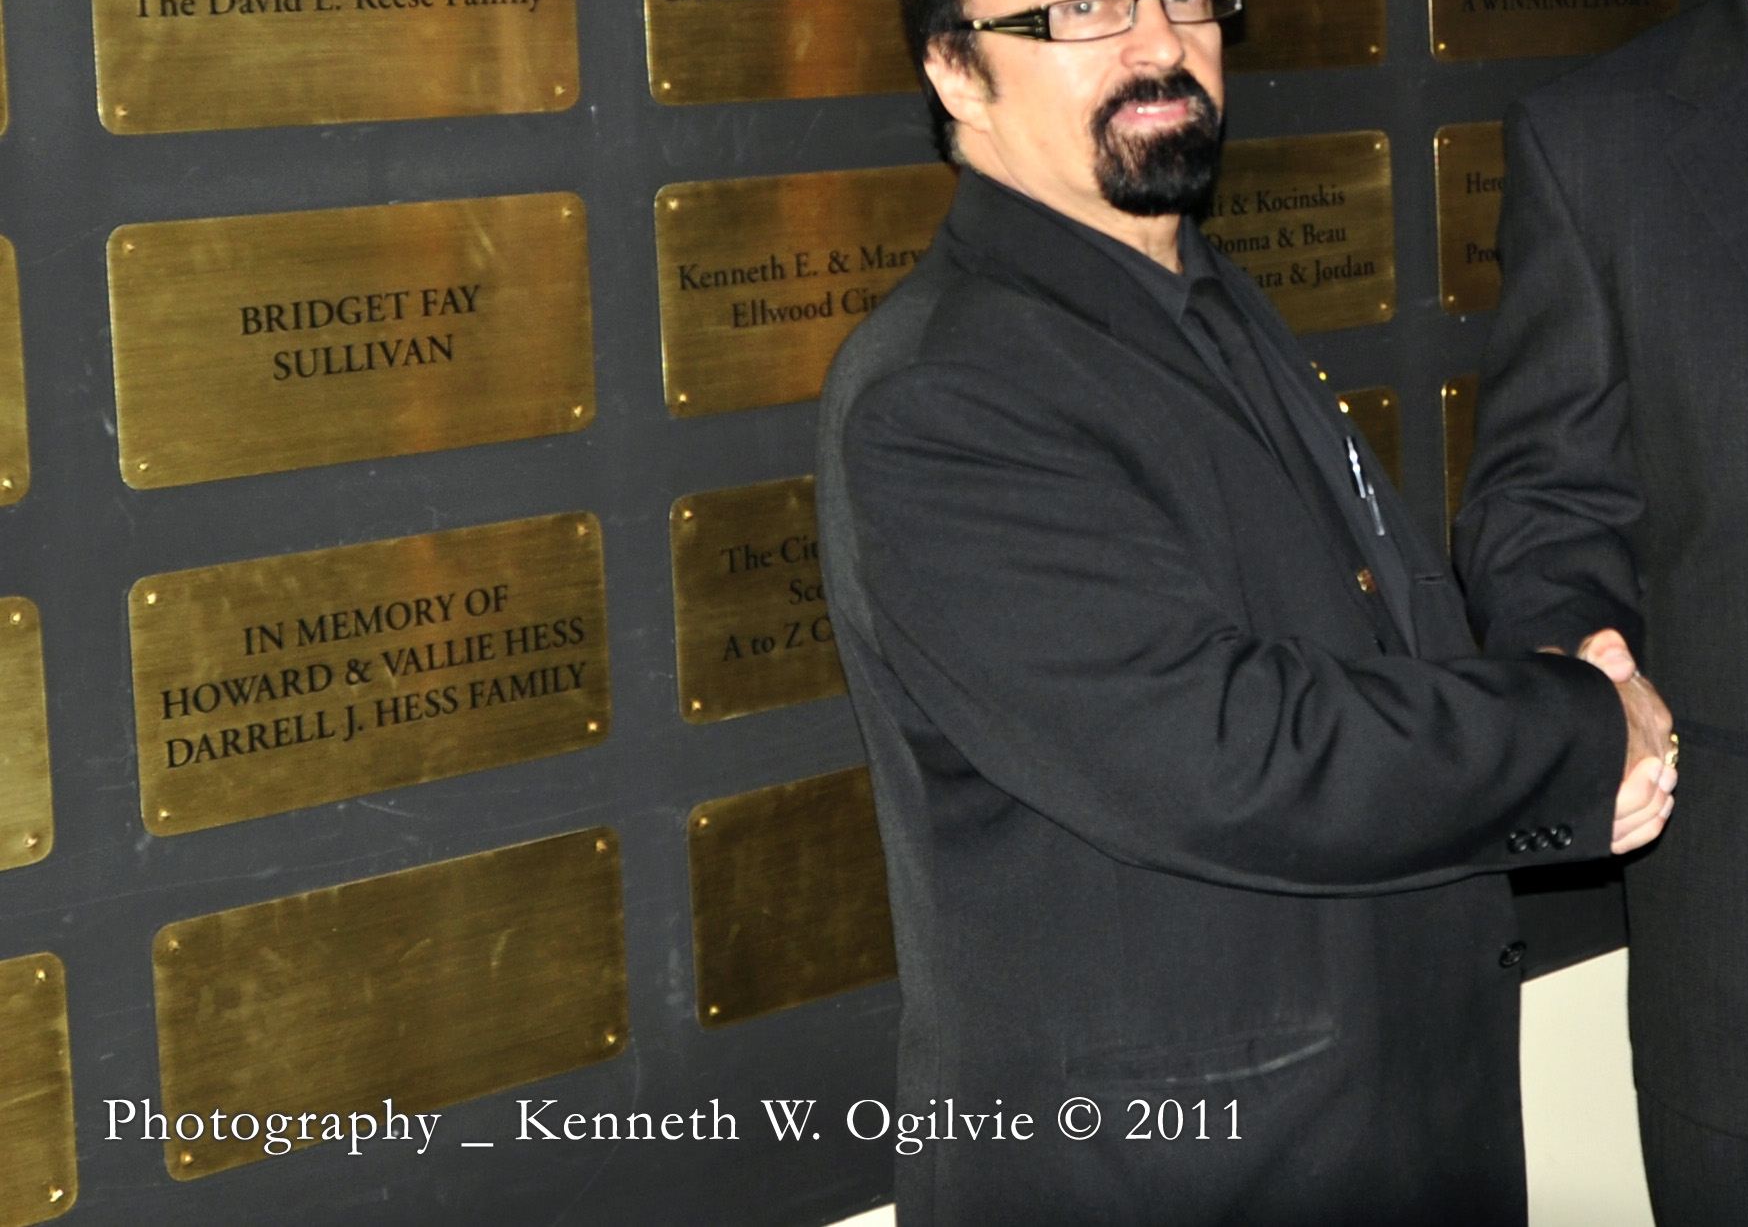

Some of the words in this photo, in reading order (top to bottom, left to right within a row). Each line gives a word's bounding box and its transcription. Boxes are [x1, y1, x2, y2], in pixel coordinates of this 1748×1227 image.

[1231, 195, 1248, 215] &
[1256, 184, 1345, 213] Kocinskis
[1278, 227, 1294, 248] &
[1303, 223, 1346, 245] Beau
[678, 254, 787, 291] Kenneth
[795, 252, 818, 279] E.
[828, 250, 850, 275] &
[1290, 262, 1307, 284] &
[1314, 255, 1376, 288] Jordan
[241, 291, 409, 335] BRIDGET
[421, 284, 481, 316] FAY
[732, 291, 834, 328] Ellwood
[274, 334, 453, 381] SULLIVAN
[720, 544, 772, 573] The
[244, 622, 284, 655] IN
[297, 593, 455, 647] MEMORY
[465, 584, 508, 616] OF
[722, 634, 743, 662] A
[752, 636, 775, 655] to
[783, 622, 804, 649] Z
[161, 663, 334, 719] HOWARD
[345, 659, 372, 685] &
[381, 633, 495, 676] VALLIE
[504, 616, 585, 656] HESS
[166, 711, 335, 768] DARRELL
[343, 705, 364, 742] J.
[374, 686, 459, 727] HESS
[469, 661, 592, 709] FAMILY
